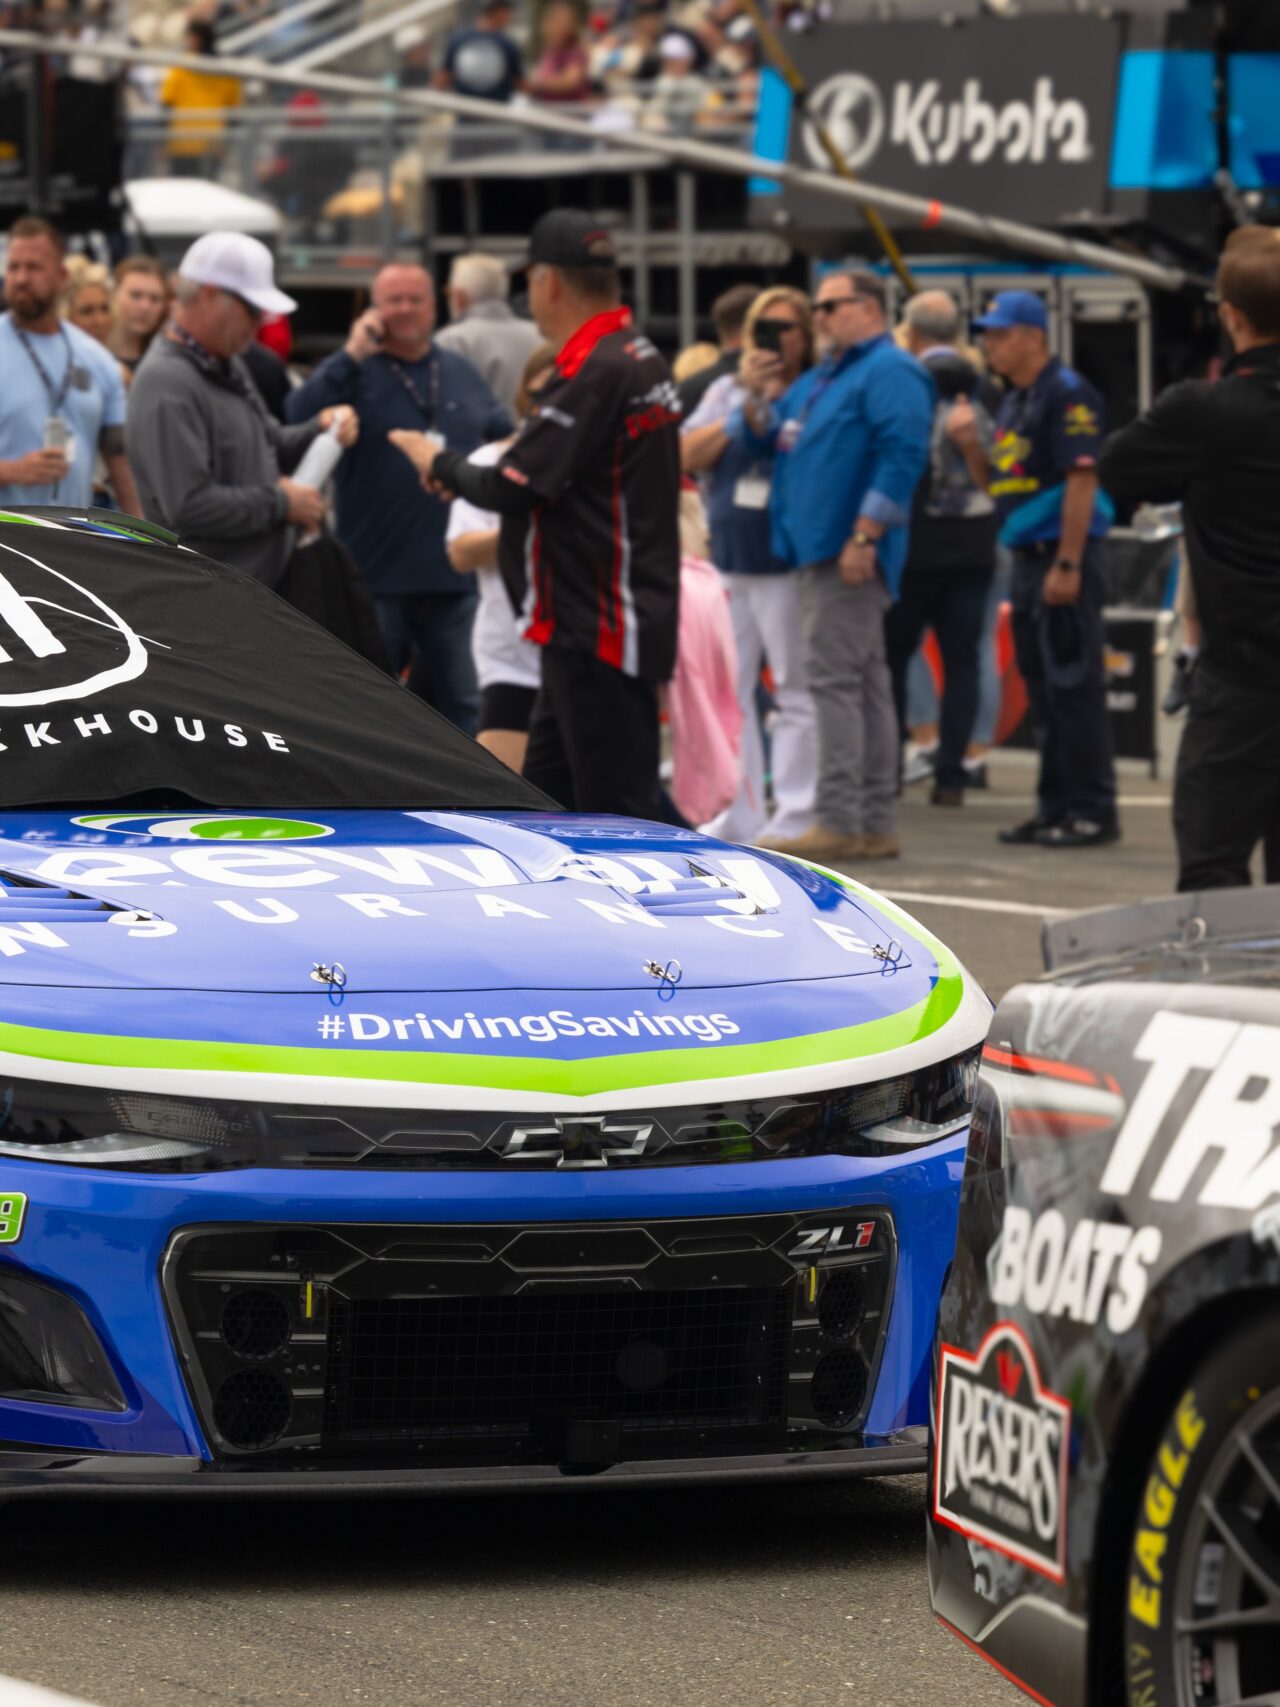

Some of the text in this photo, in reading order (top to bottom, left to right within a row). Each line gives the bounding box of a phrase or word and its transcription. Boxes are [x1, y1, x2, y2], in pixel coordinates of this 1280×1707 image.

[890, 76, 1090, 165] Kubota
[317, 1010, 741, 1042] #DrivingSavings
[787, 1220, 877, 1256] ZL1
[990, 1205, 1163, 1333] BOATS
[943, 1373, 1060, 1542] RESER'S
[1128, 1388, 1207, 1629] EAGLE
